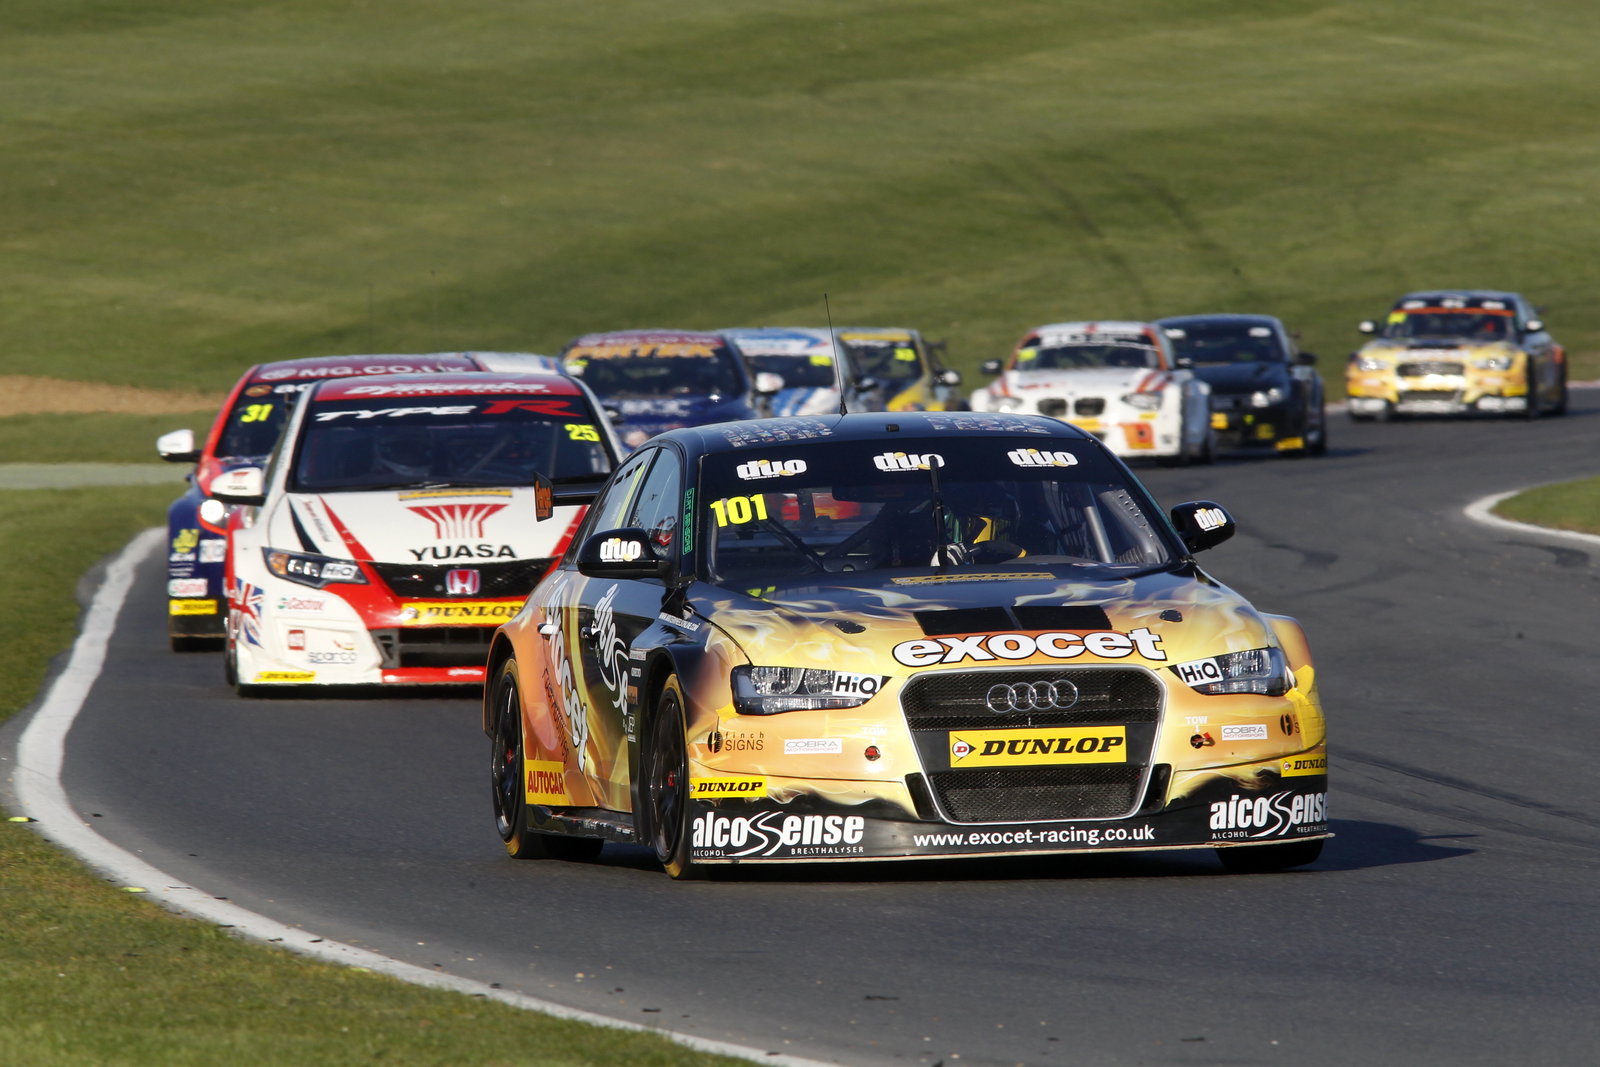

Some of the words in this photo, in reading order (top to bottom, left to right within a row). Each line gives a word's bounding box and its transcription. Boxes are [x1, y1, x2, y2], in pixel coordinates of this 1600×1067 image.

[241, 403, 273, 423] 31
[316, 405, 477, 422] TYPE
[480, 400, 584, 417] R
[564, 423, 600, 442] 25
[873, 452, 945, 471] duo
[1007, 448, 1079, 467] duo
[736, 459, 807, 479] duo
[710, 494, 768, 528] 101
[1194, 508, 1227, 530] duo
[408, 544, 517, 561] YUASA
[600, 537, 641, 561] duo
[893, 627, 1168, 667] exocet
[1180, 662, 1220, 684] HiQ
[835, 674, 878, 694] HiQ
[1185, 716, 1209, 726] TOW
[1223, 726, 1265, 734] COBRA
[725, 731, 765, 739] finch
[725, 739, 764, 751] SIGNS
[980, 736, 1124, 757] DUNLOP
[1294, 759, 1328, 770] DUNLO
[527, 770, 566, 795] AUTOCAR
[698, 782, 763, 793] DUNLOP
[693, 811, 865, 856] alcoSense
[914, 824, 1155, 847] www.exocet-racing.co.uk
[1212, 831, 1249, 840] ALCOHOL
[791, 846, 864, 855] BREATHALYSER
